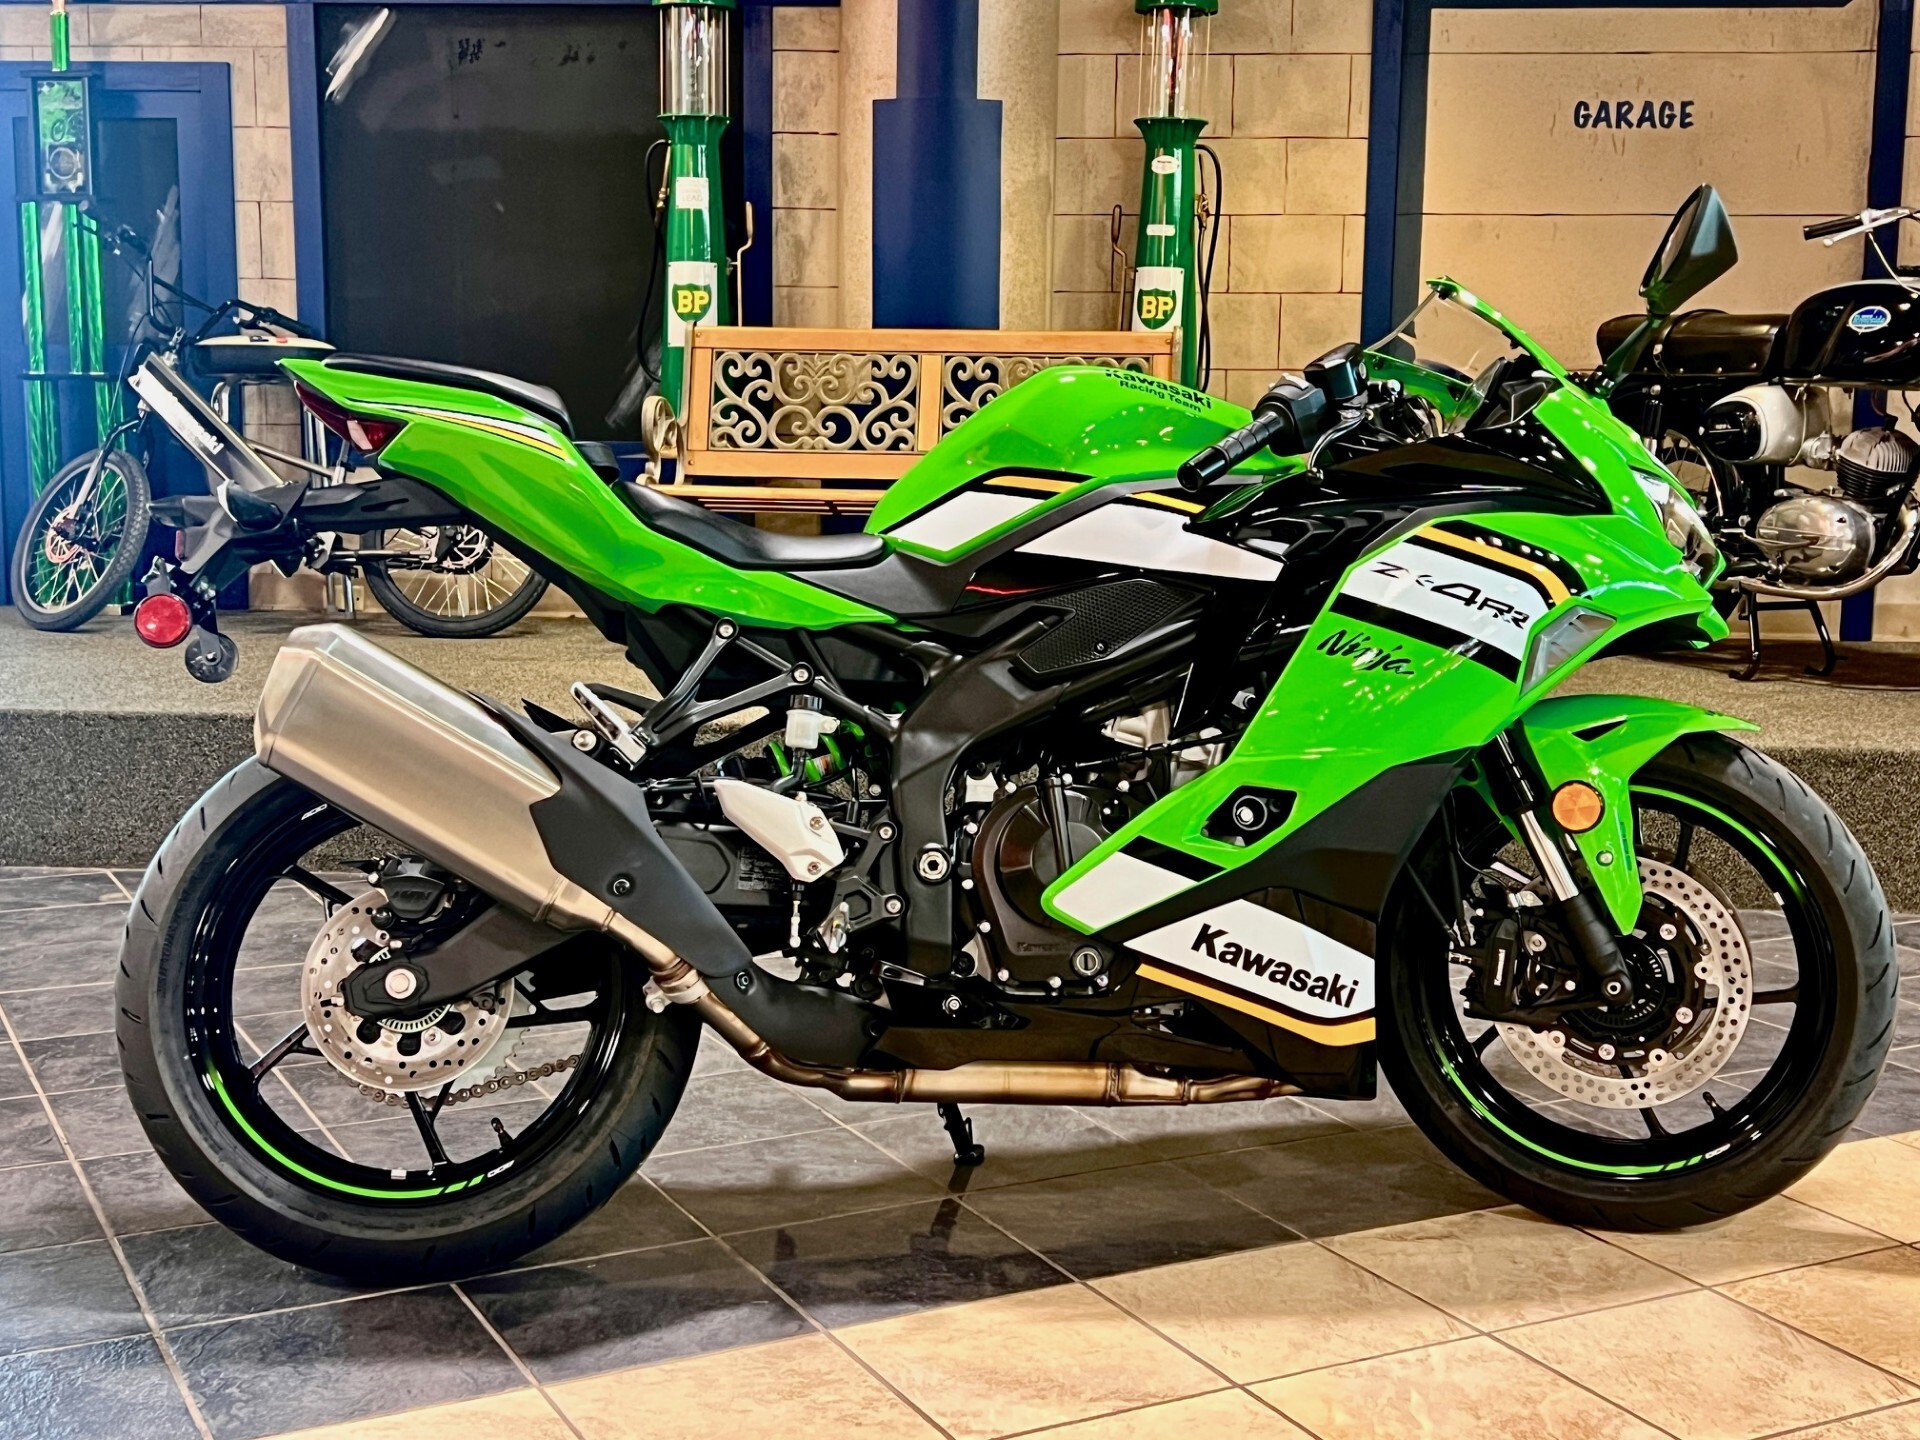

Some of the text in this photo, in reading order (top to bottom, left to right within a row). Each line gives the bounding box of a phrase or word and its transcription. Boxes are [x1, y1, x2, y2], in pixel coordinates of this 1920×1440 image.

[1574, 101, 1694, 129] GARAGE
[677, 290, 709, 313] BP
[1141, 296, 1173, 319] BP
[1105, 369, 1212, 409] Kawasaki
[1120, 380, 1201, 413] Racing Team
[1316, 629, 1414, 674] Ninja
[1191, 923, 1359, 1009] Kawasaki
